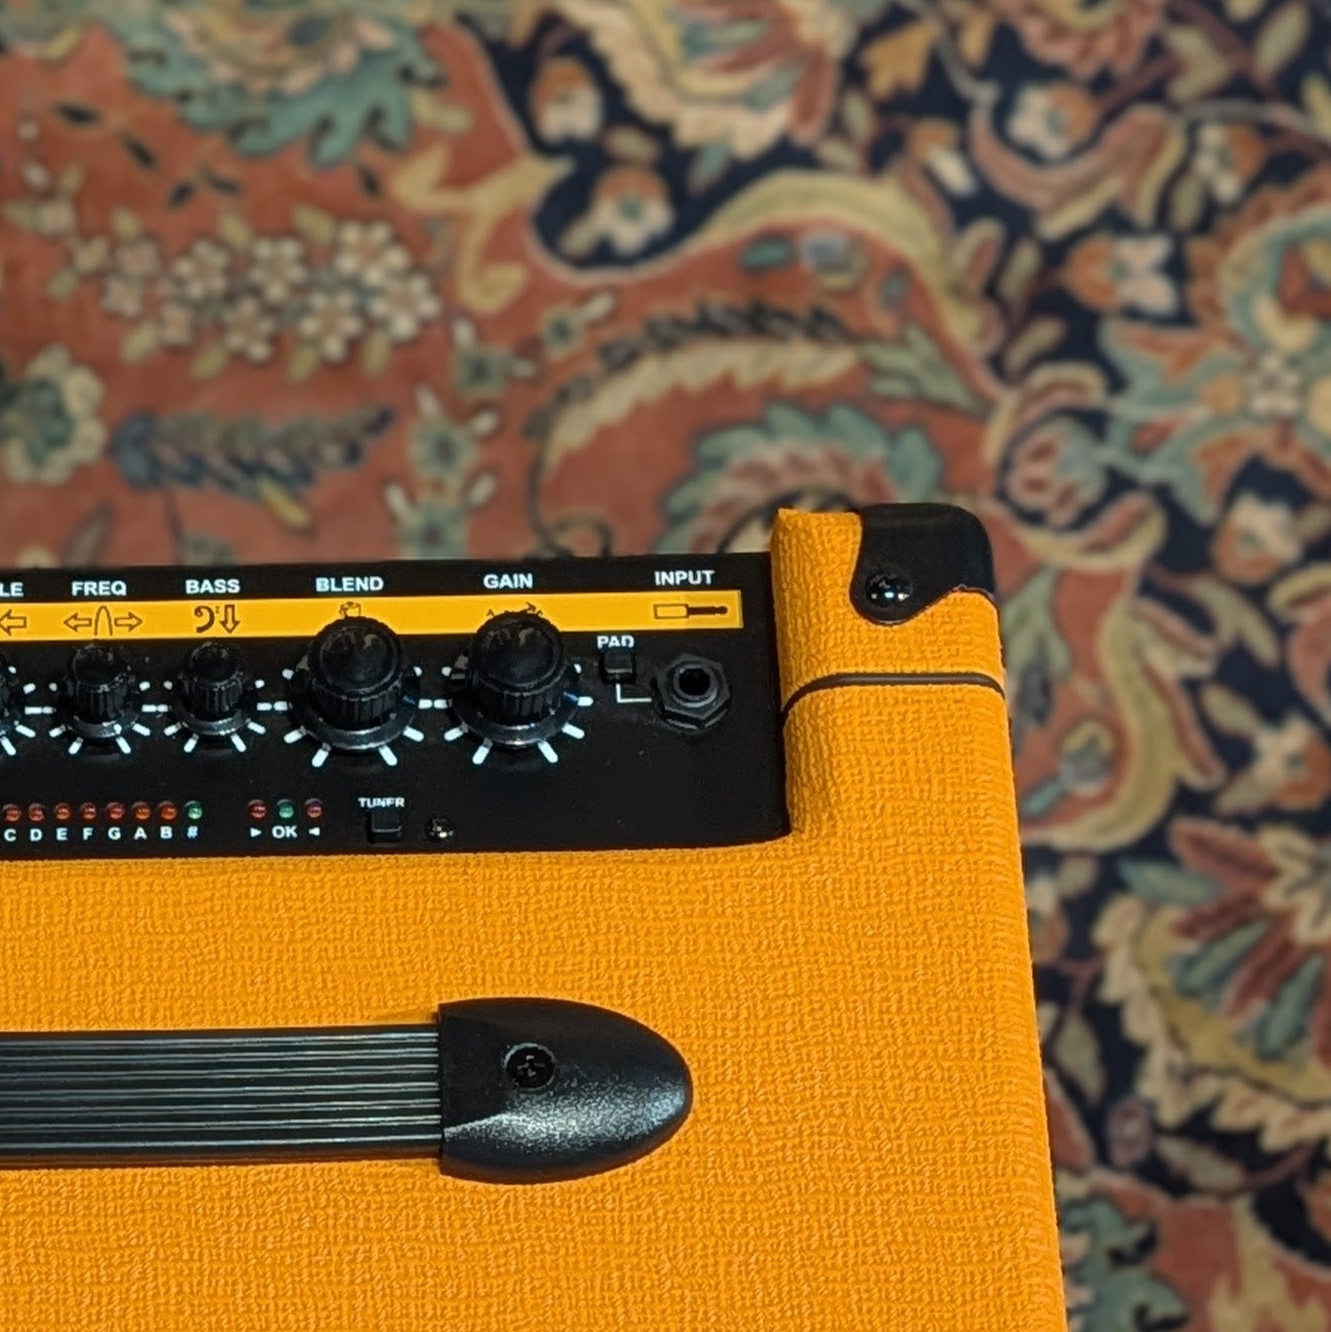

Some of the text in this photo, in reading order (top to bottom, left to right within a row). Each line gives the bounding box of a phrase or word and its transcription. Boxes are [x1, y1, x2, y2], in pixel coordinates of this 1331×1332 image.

[315, 576, 385, 593] BLEND
[482, 572, 534, 589] GAIN
[654, 569, 715, 586] INPUT
[71, 580, 127, 597] FREQ
[185, 578, 241, 595] BASS
[597, 635, 635, 649] PAD
[3, 825, 198, 842] C D E F G A B #
[271, 825, 298, 839] OK
